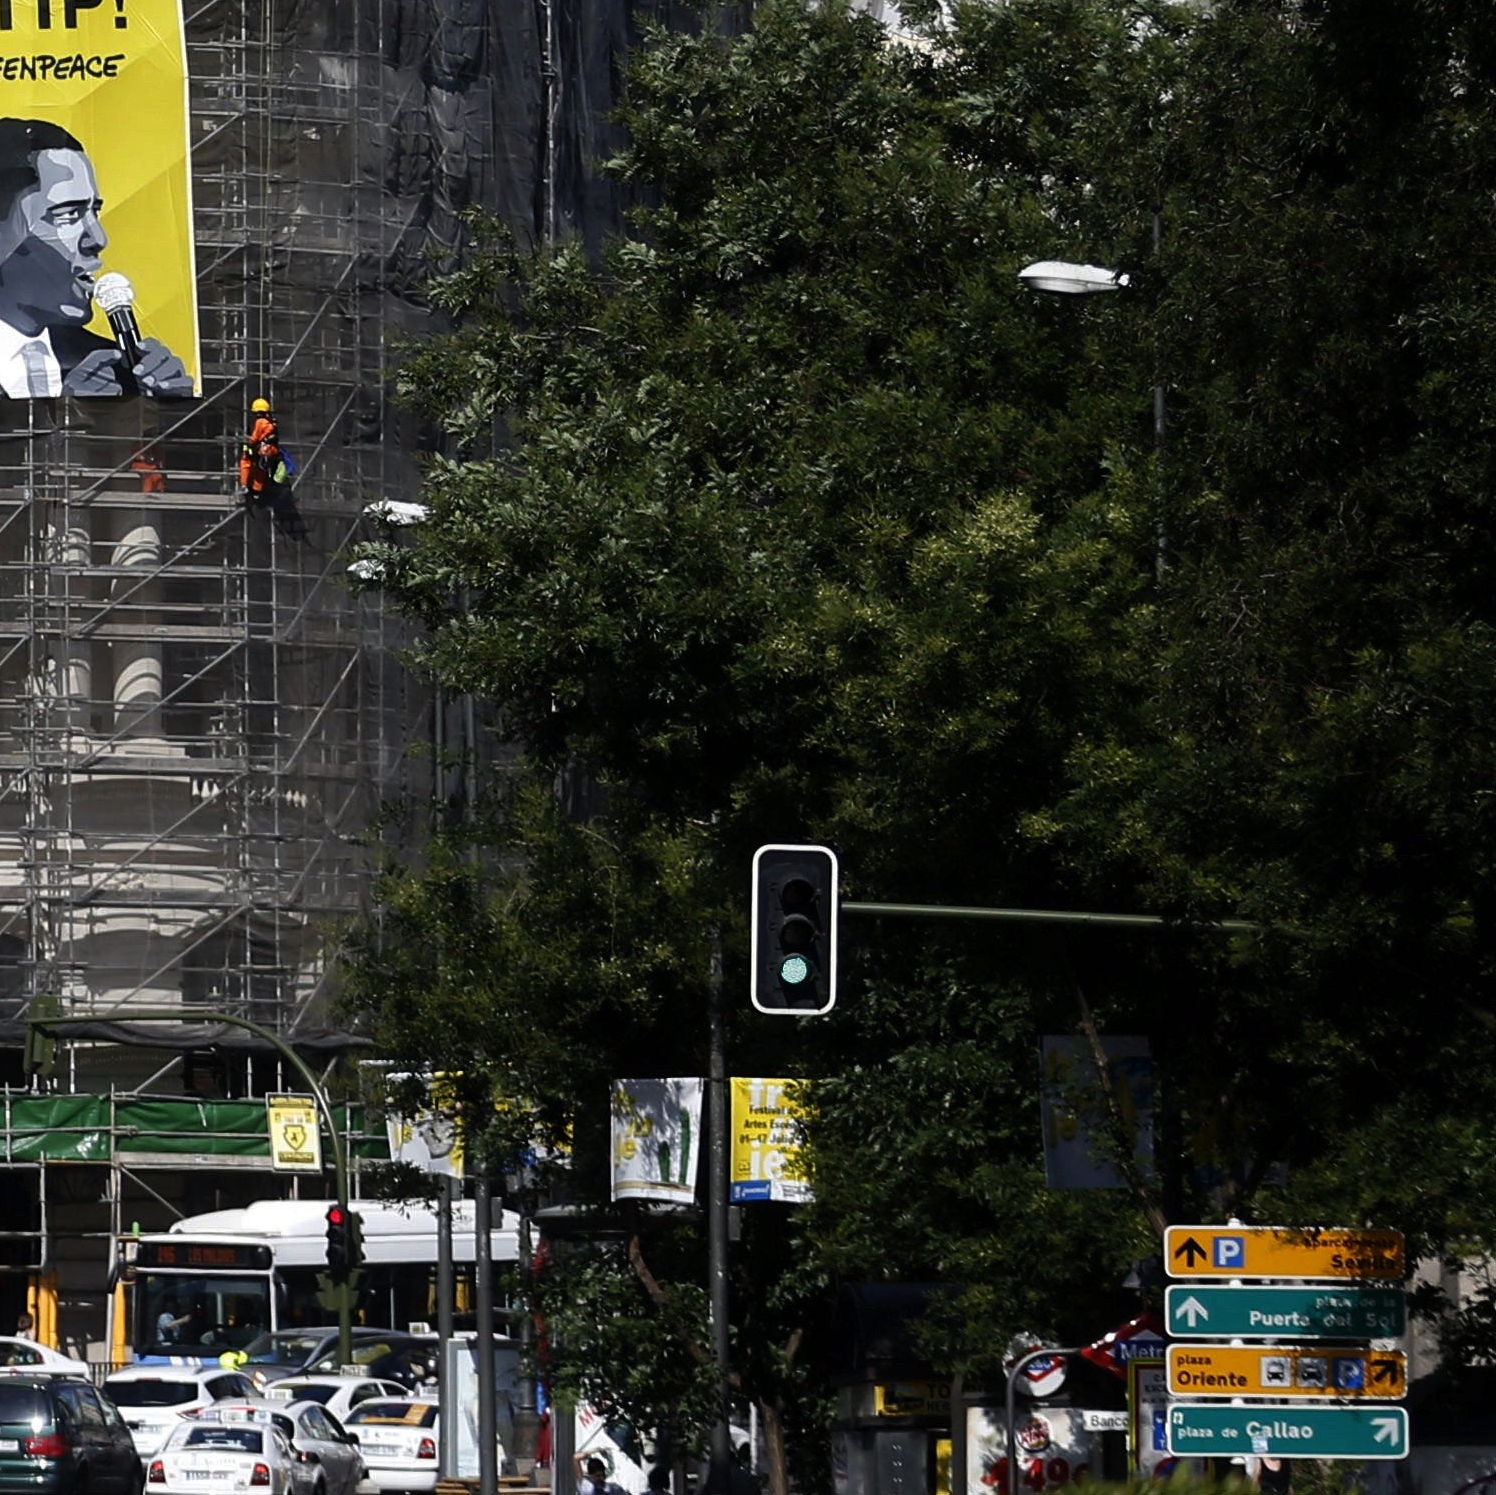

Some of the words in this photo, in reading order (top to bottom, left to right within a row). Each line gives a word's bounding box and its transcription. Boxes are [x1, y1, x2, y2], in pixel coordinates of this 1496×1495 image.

[749, 1106, 785, 1115] Festival
[744, 1120, 767, 1128] Artes
[769, 1134, 791, 1144] Julio
[1219, 1240, 1240, 1265] P
[1250, 1310, 1311, 1326] Puerta
[1323, 1312, 1353, 1327] del
[1365, 1312, 1397, 1327] Sol
[1120, 1343, 1165, 1359] Metr
[1177, 1354, 1212, 1366] plaza
[1177, 1370, 1248, 1387] Oriente
[1178, 1427, 1213, 1439] plaza
[1221, 1427, 1238, 1438] de
[1246, 1421, 1314, 1439] Callao
